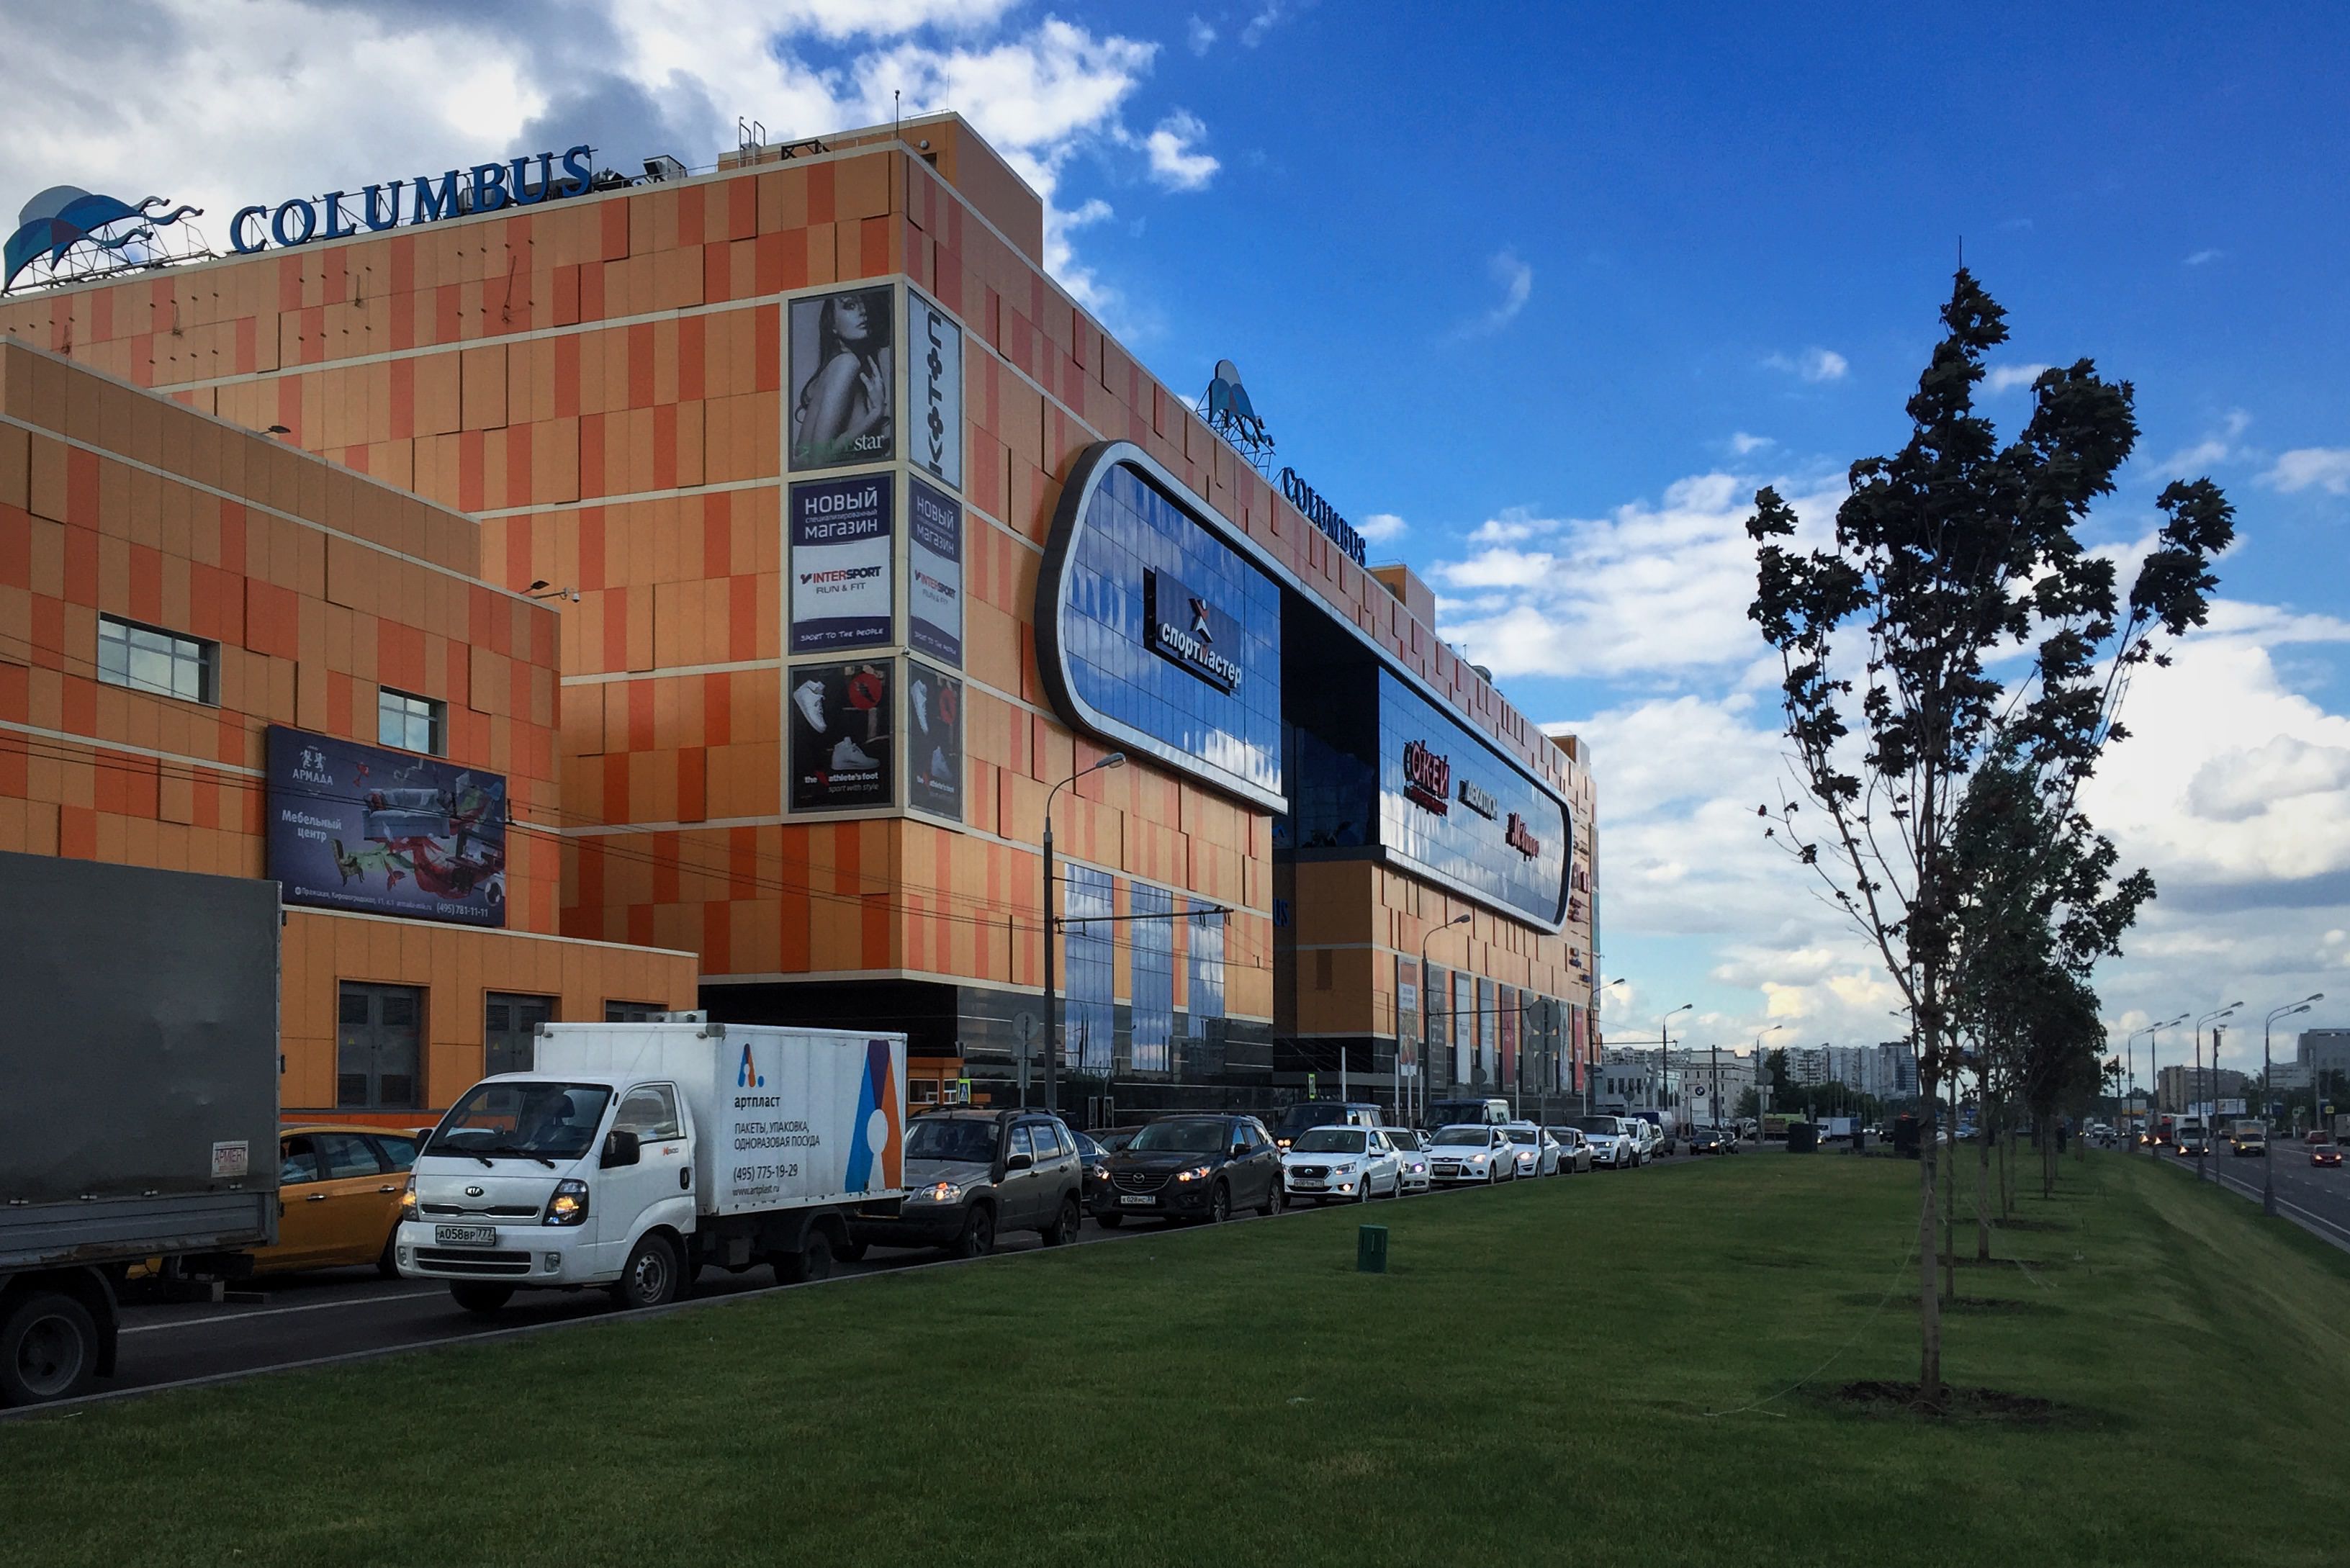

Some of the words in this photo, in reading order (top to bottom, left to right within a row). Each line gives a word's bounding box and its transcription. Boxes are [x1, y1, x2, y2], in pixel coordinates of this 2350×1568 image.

[230, 145, 592, 254] COLUMBUS
[854, 434, 885, 451] star
[1283, 467, 1367, 568] COLUMBUS
[805, 518, 878, 539] магазин
[813, 565, 883, 584] INTERSPORT
[816, 585, 839, 594] RUN
[842, 584, 847, 592] &
[850, 582, 866, 591] FIT
[856, 628, 883, 636] PEOPLE
[292, 768, 333, 785] АРМАДА
[828, 772, 861, 782] athlete's
[282, 809, 342, 830] Мебельный
[734, 1096, 781, 1110] артпласт
[734, 1122, 769, 1135] ПАКЕТЫ,
[769, 1121, 809, 1133] УПАКОВКА,
[734, 1136, 790, 1151] ОДНОРАЗОВАЯ
[791, 1135, 820, 1148] ПОСУДА
[733, 1166, 755, 1183] (495)
[757, 1163, 798, 1179] 775-19-29
[439, 1228, 476, 1240] А058ВР
